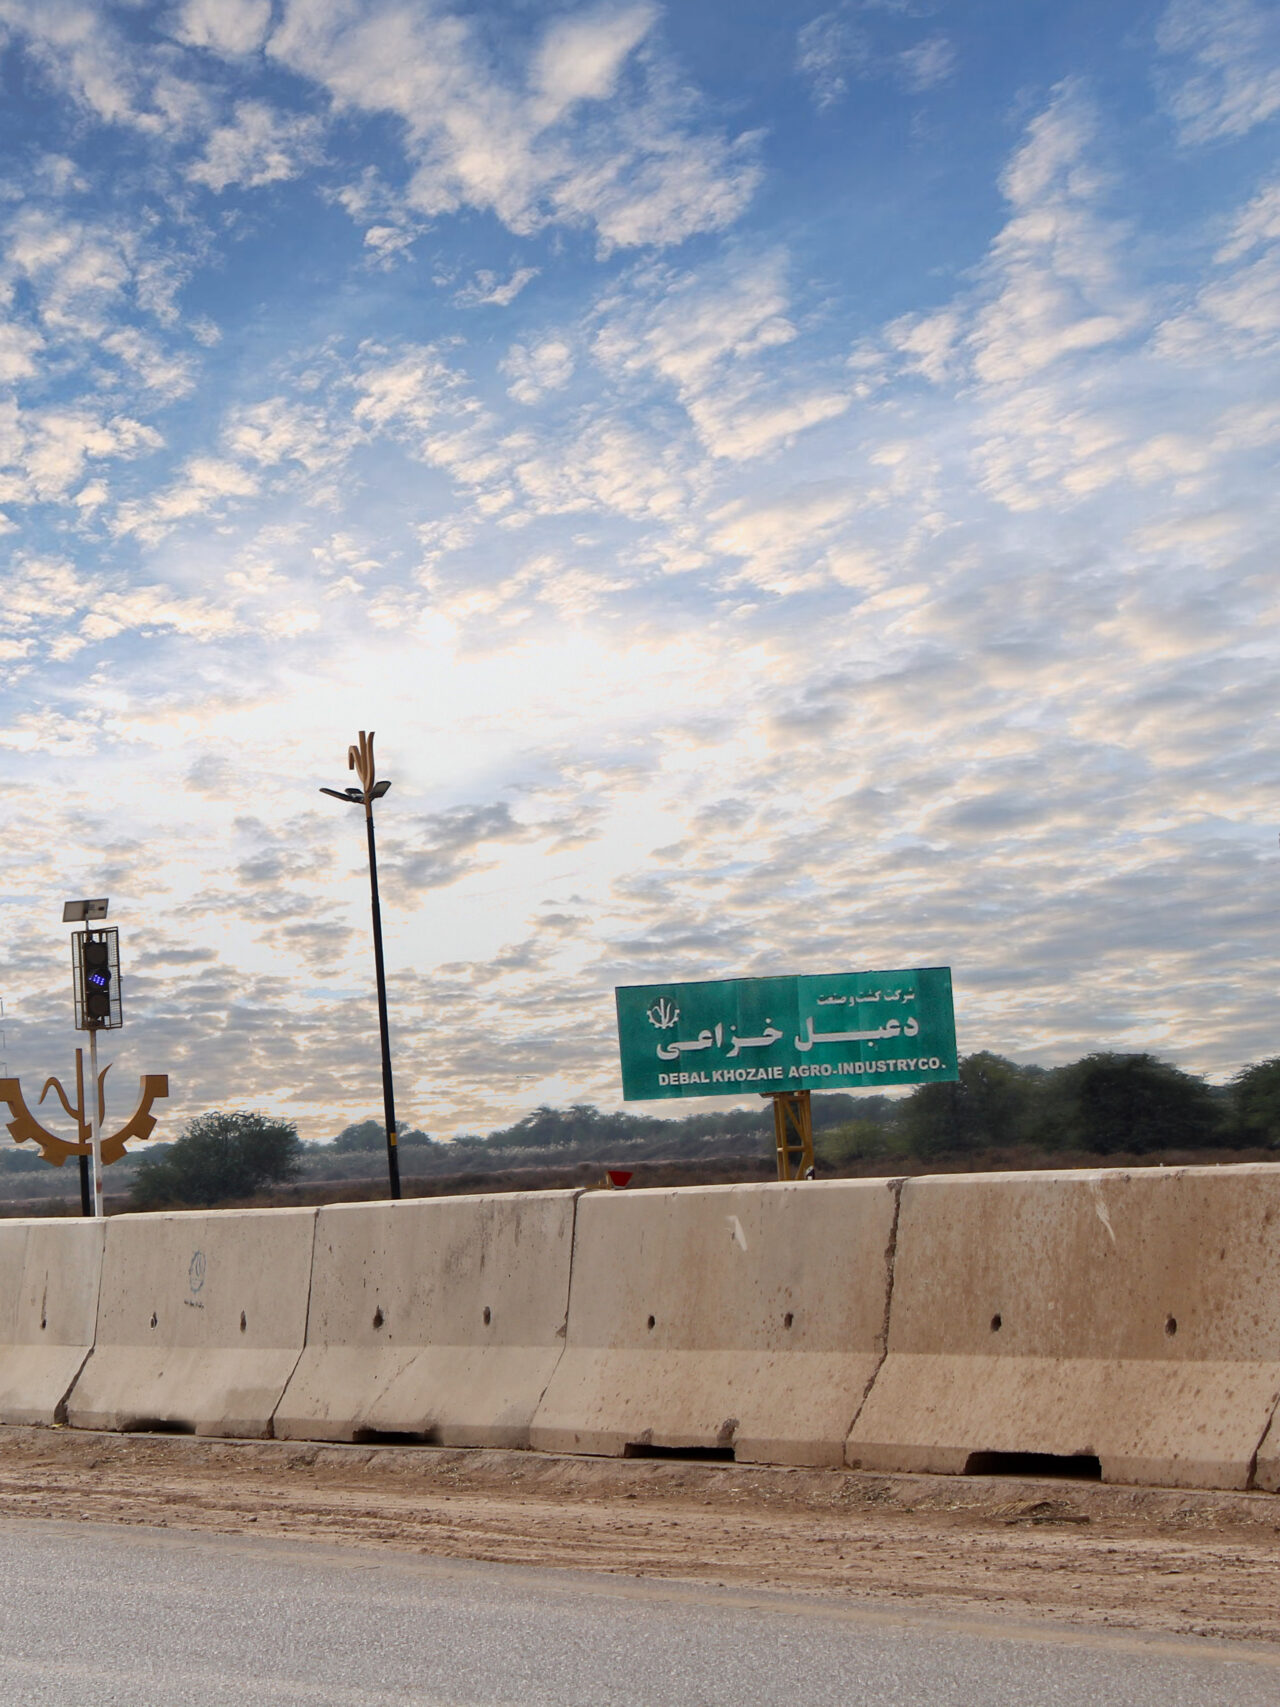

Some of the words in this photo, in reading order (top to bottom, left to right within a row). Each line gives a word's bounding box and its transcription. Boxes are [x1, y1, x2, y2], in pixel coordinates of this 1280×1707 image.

[817, 992, 847, 1005] صنعت
[848, 996, 856, 1007] و
[856, 989, 881, 1003] کشت
[884, 987, 915, 1004] شرکت
[656, 1017, 783, 1060] خزاعی
[794, 1016, 919, 1052] دعبل
[658, 1071, 710, 1086] DEBAL
[712, 1066, 783, 1082] KHOZAIE
